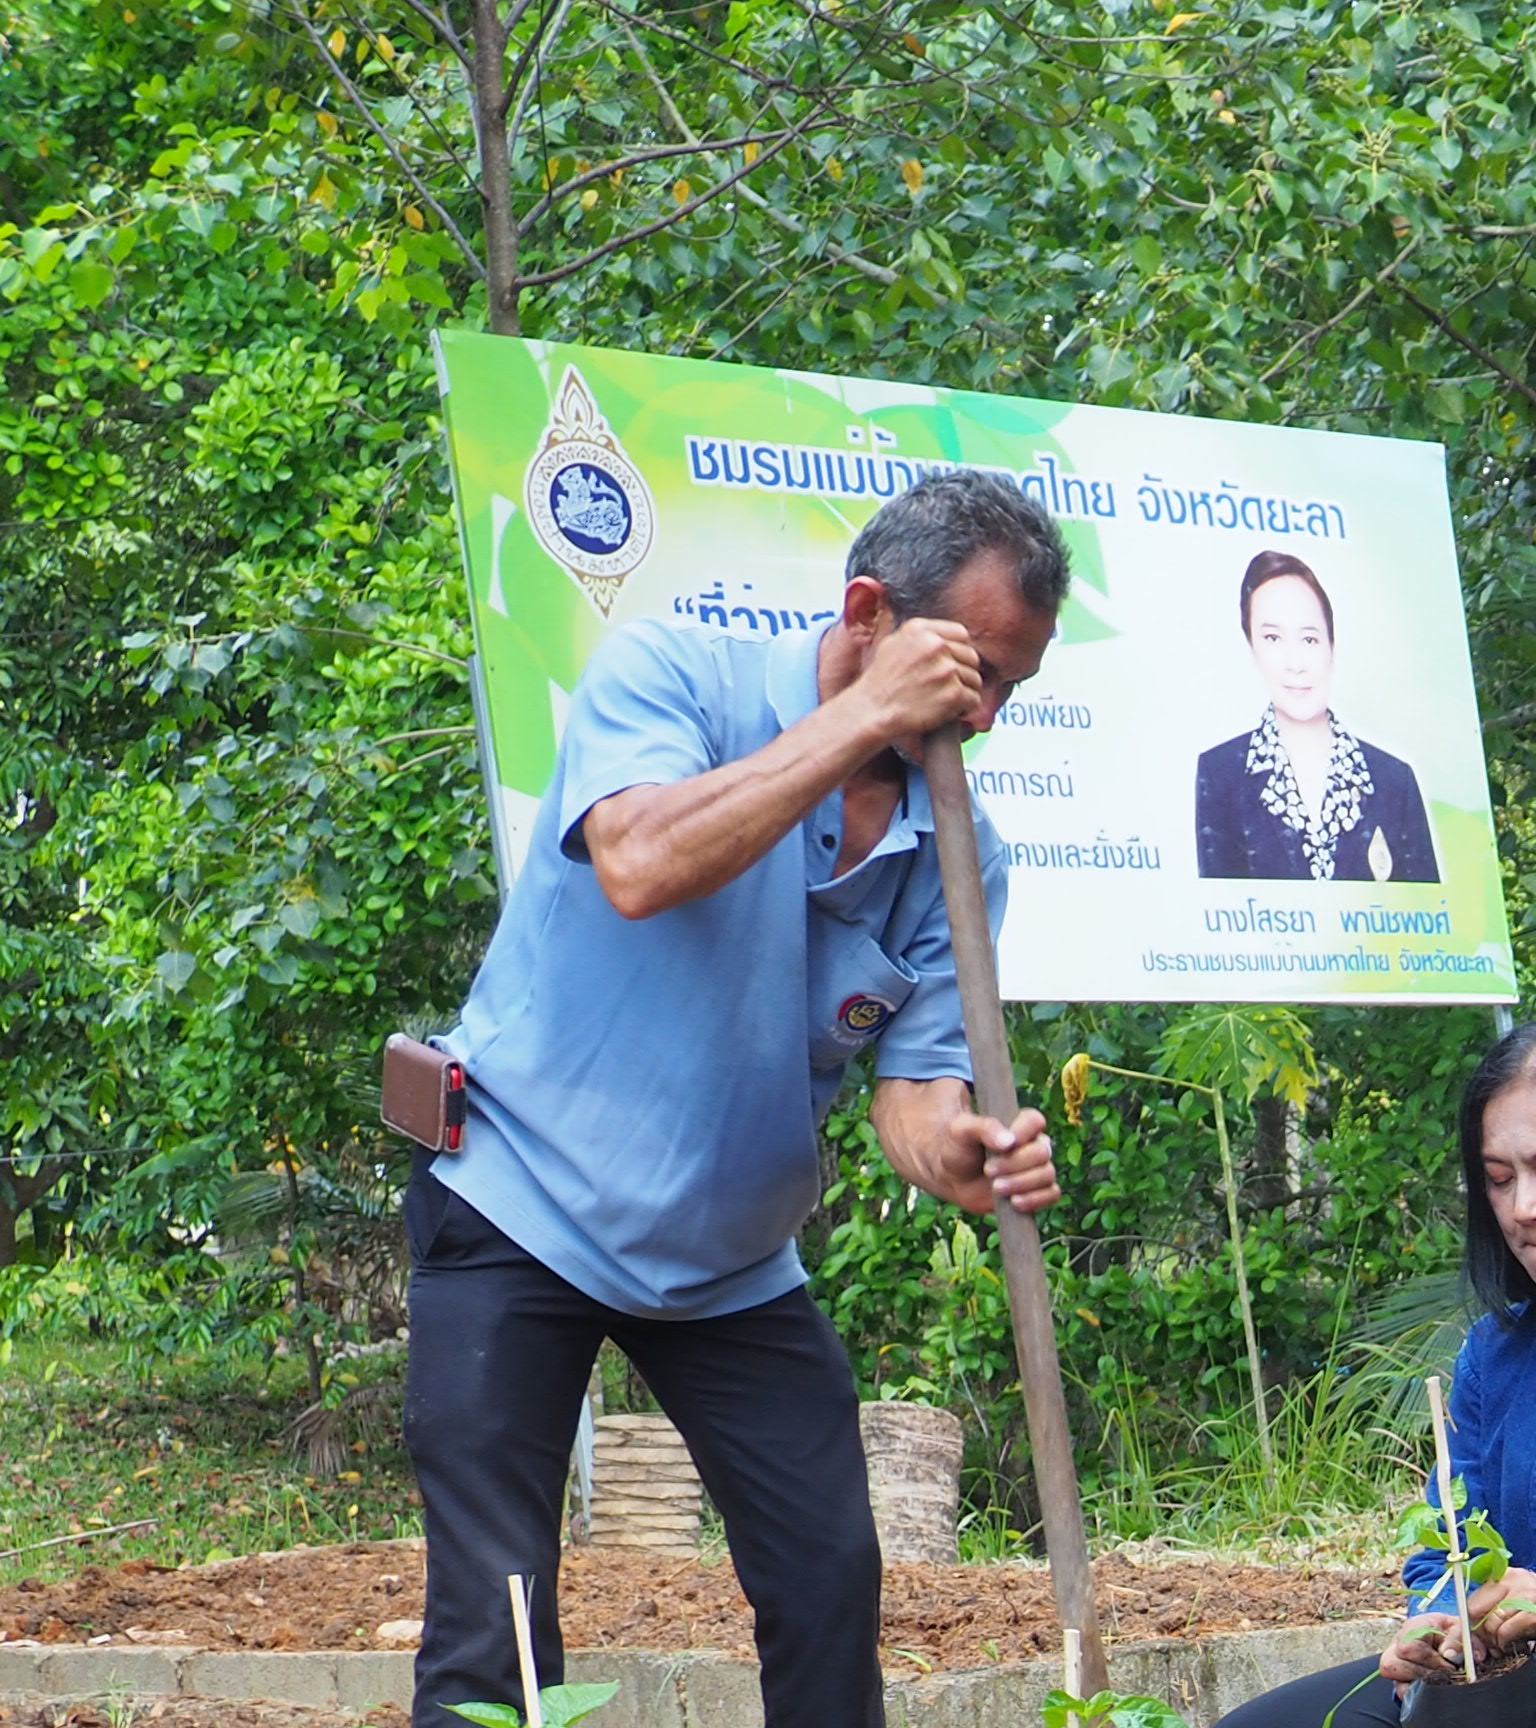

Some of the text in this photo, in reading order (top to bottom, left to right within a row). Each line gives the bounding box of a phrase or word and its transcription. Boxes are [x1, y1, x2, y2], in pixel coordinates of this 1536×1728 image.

[1138, 474, 1346, 538] จังหวัดยะลา
[1006, 828, 1161, 870] คงและยั่งยืน
[1204, 897, 1450, 935] นางโสรยา พานิชพงศ์
[1142, 942, 1494, 973] ประธานชมรมแม่บ้านมหาดไทย จังหวัดยะลา
